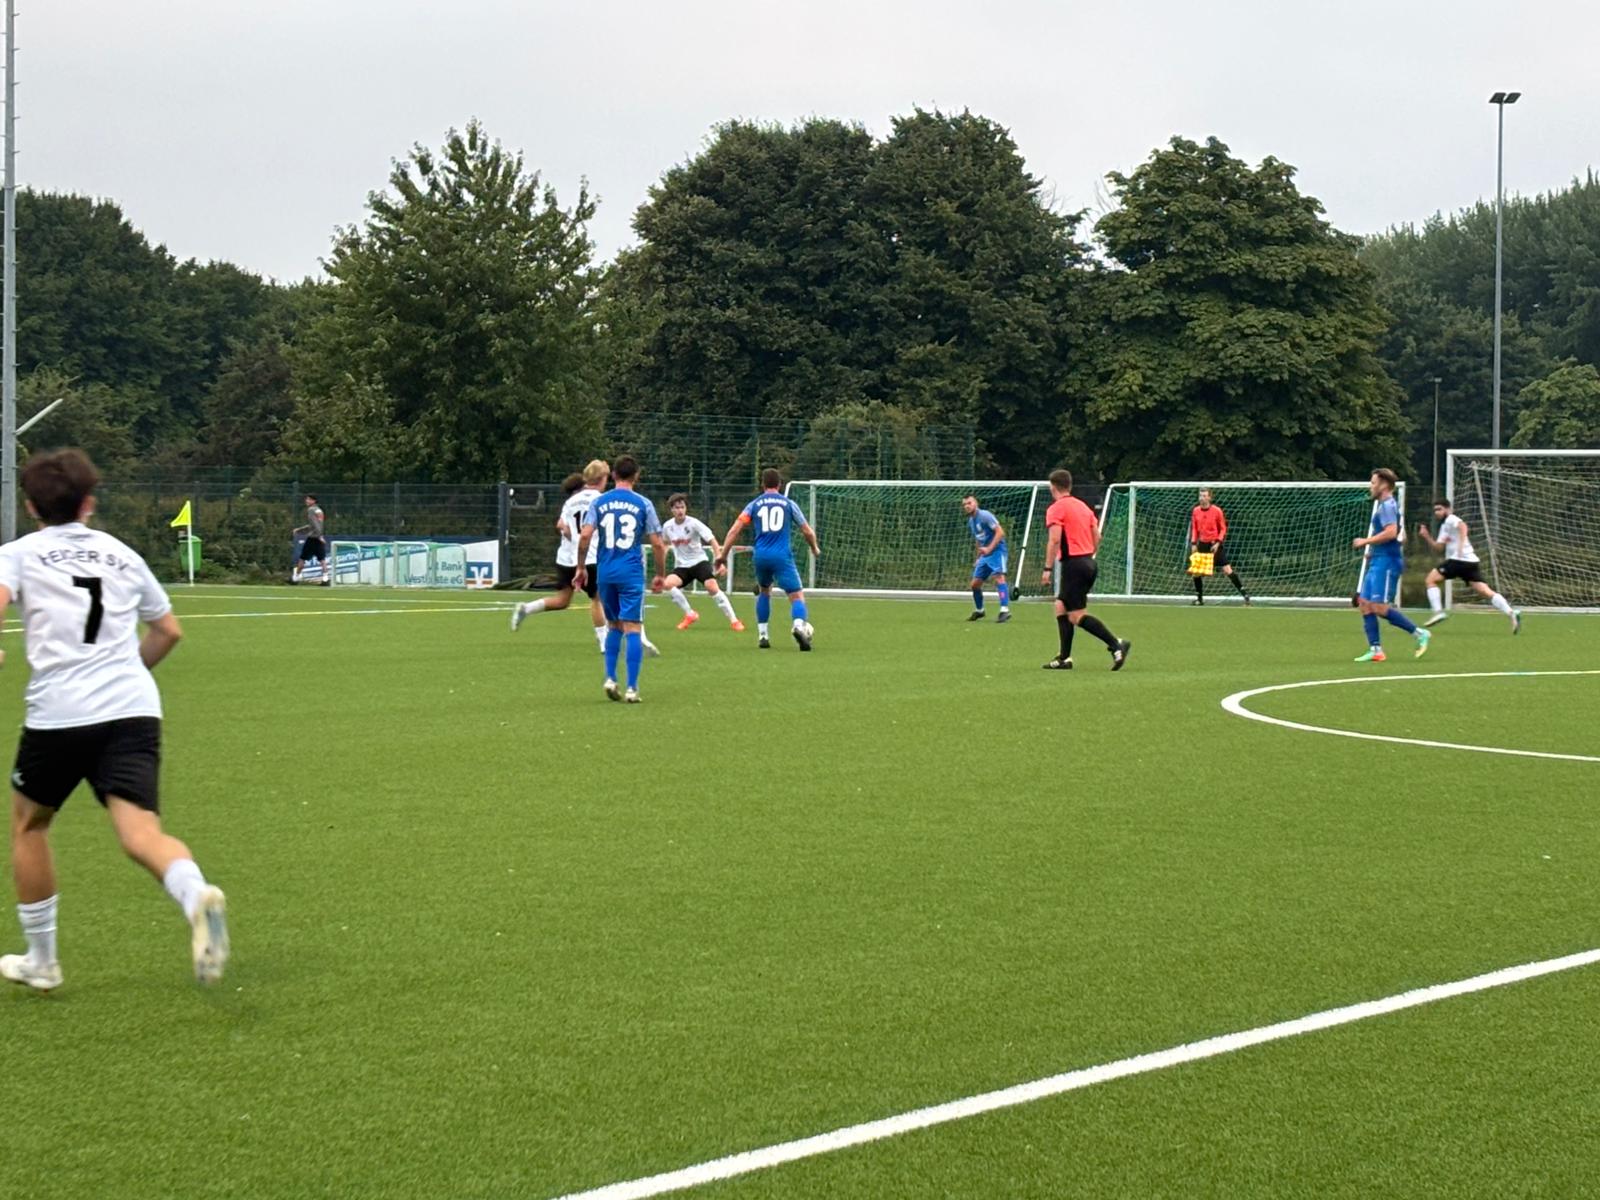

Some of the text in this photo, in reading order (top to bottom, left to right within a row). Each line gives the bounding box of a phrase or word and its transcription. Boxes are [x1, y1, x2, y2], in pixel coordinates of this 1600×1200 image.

[600, 513, 637, 550] 13
[757, 505, 785, 532] 10
[441, 560, 463, 571] Bank
[72, 575, 104, 645] 7
